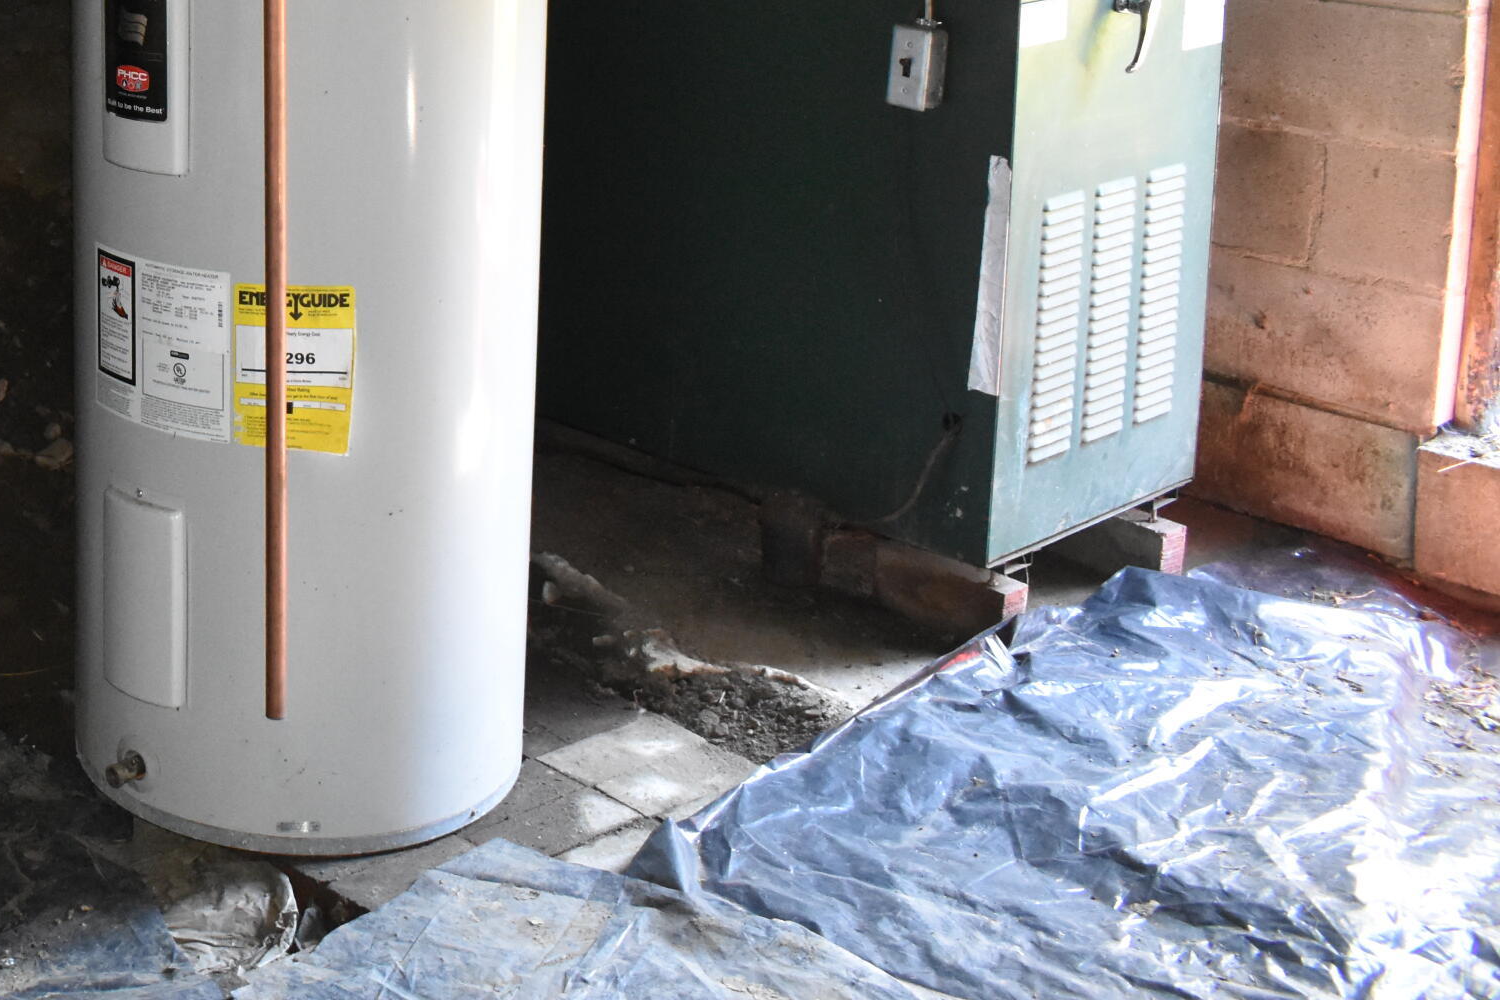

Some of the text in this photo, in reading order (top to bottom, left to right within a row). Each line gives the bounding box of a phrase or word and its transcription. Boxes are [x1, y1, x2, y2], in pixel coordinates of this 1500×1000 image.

[117, 68, 148, 82] PHCC
[133, 105, 144, 113] the
[146, 106, 163, 115] Best
